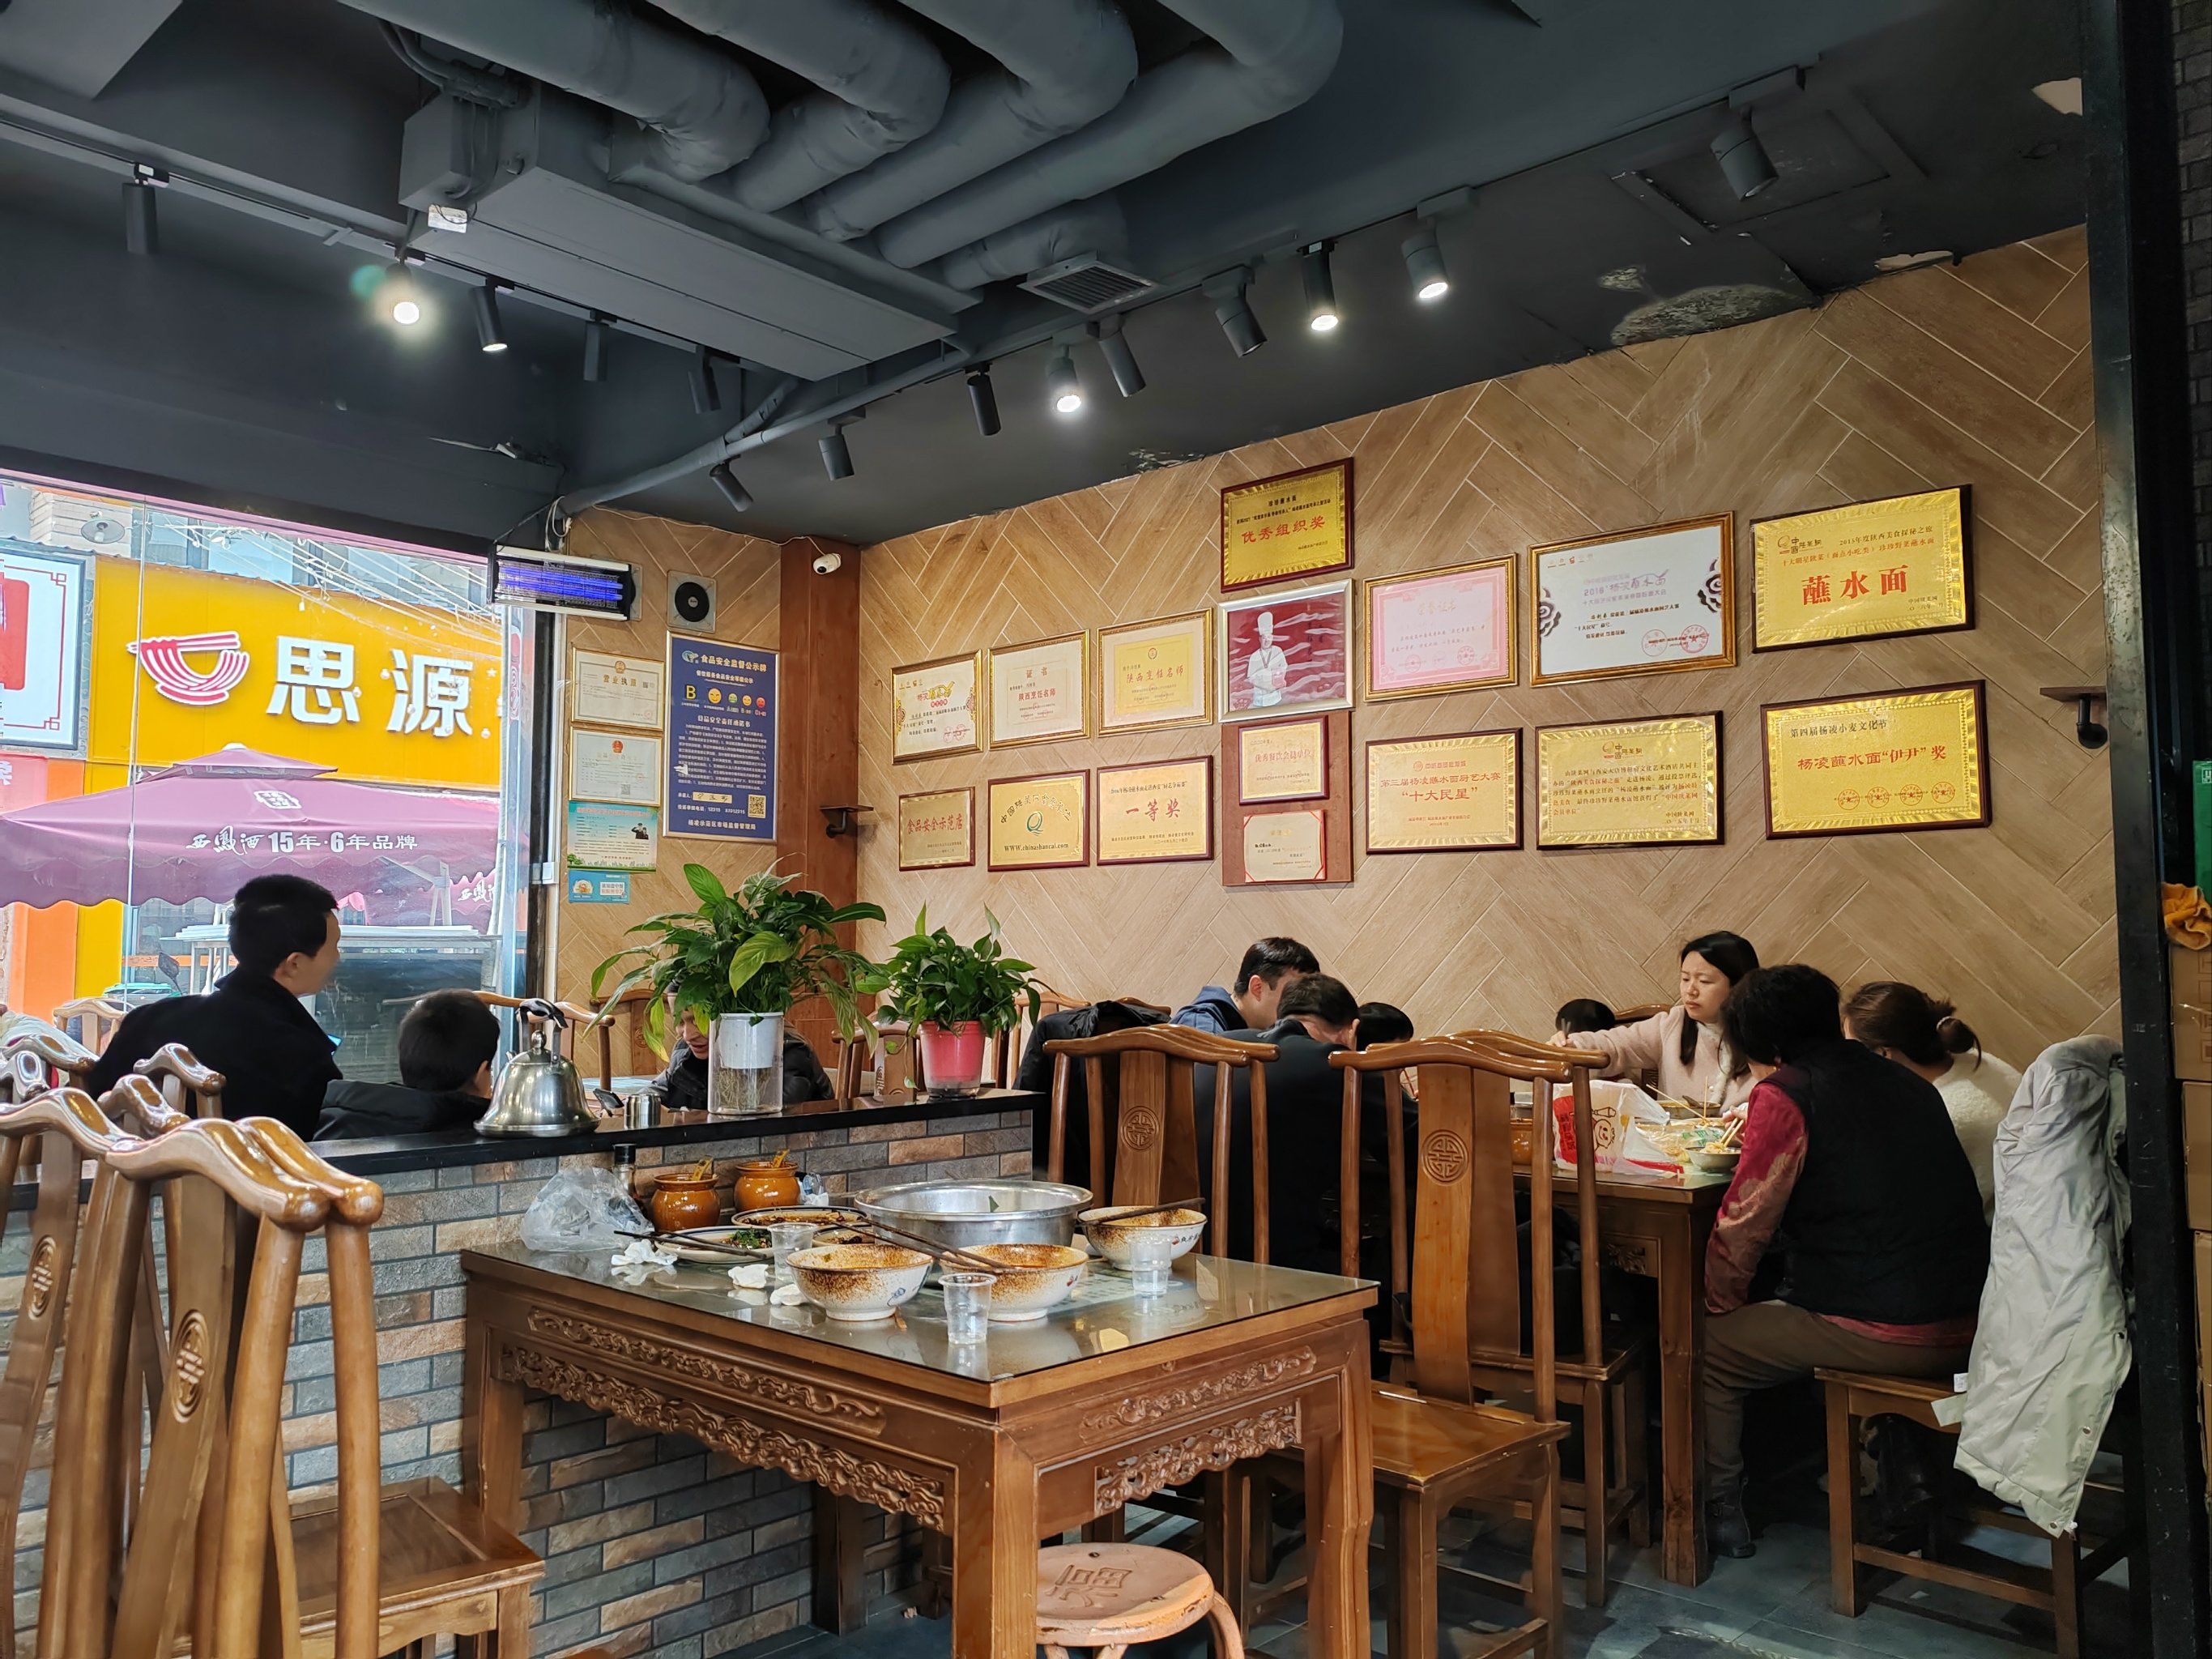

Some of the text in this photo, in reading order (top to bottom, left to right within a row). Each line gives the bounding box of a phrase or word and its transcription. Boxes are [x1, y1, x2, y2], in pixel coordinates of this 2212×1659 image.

[1242, 515, 1325, 544] 优秀组织奖
[1801, 565, 1908, 606] 蘸水面
[701, 655, 767, 672] 食品安全监督公示牌
[266, 634, 473, 737] 思源
[603, 674, 637, 687] 营业执照
[686, 684, 697, 700] B
[1018, 688, 1056, 702] 陕西烹饪名师
[1789, 719, 1887, 739] 第四届杨凌小麦文化节
[1126, 798, 1181, 822] 一等奖
[907, 813, 963, 834] 食品安全示范店
